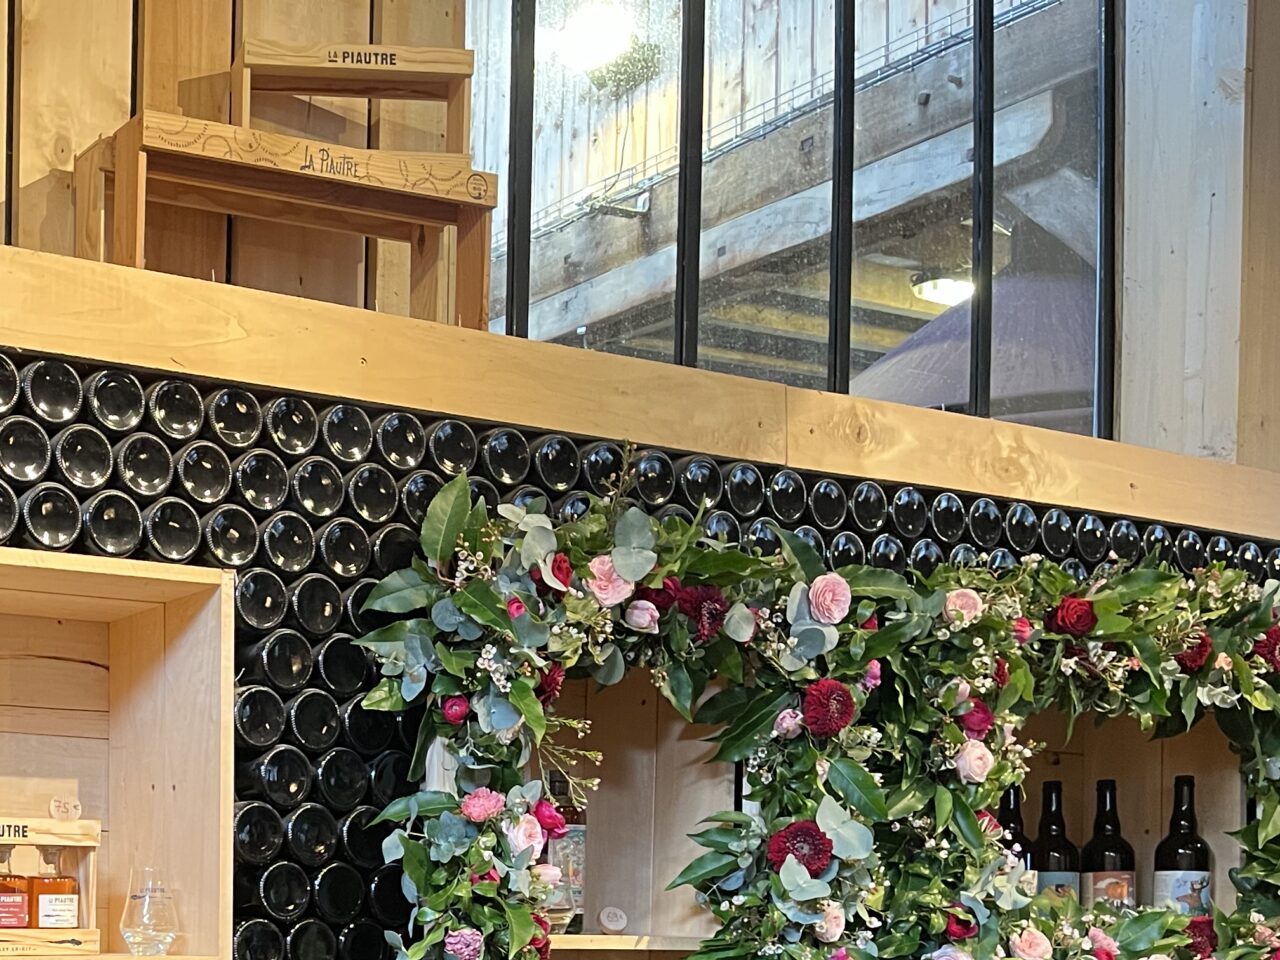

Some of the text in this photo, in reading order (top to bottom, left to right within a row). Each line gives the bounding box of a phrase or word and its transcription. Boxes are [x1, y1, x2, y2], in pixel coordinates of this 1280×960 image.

[328, 51, 397, 65] LA PIAUTRE
[300, 145, 361, 178] LA PIAUTRE
